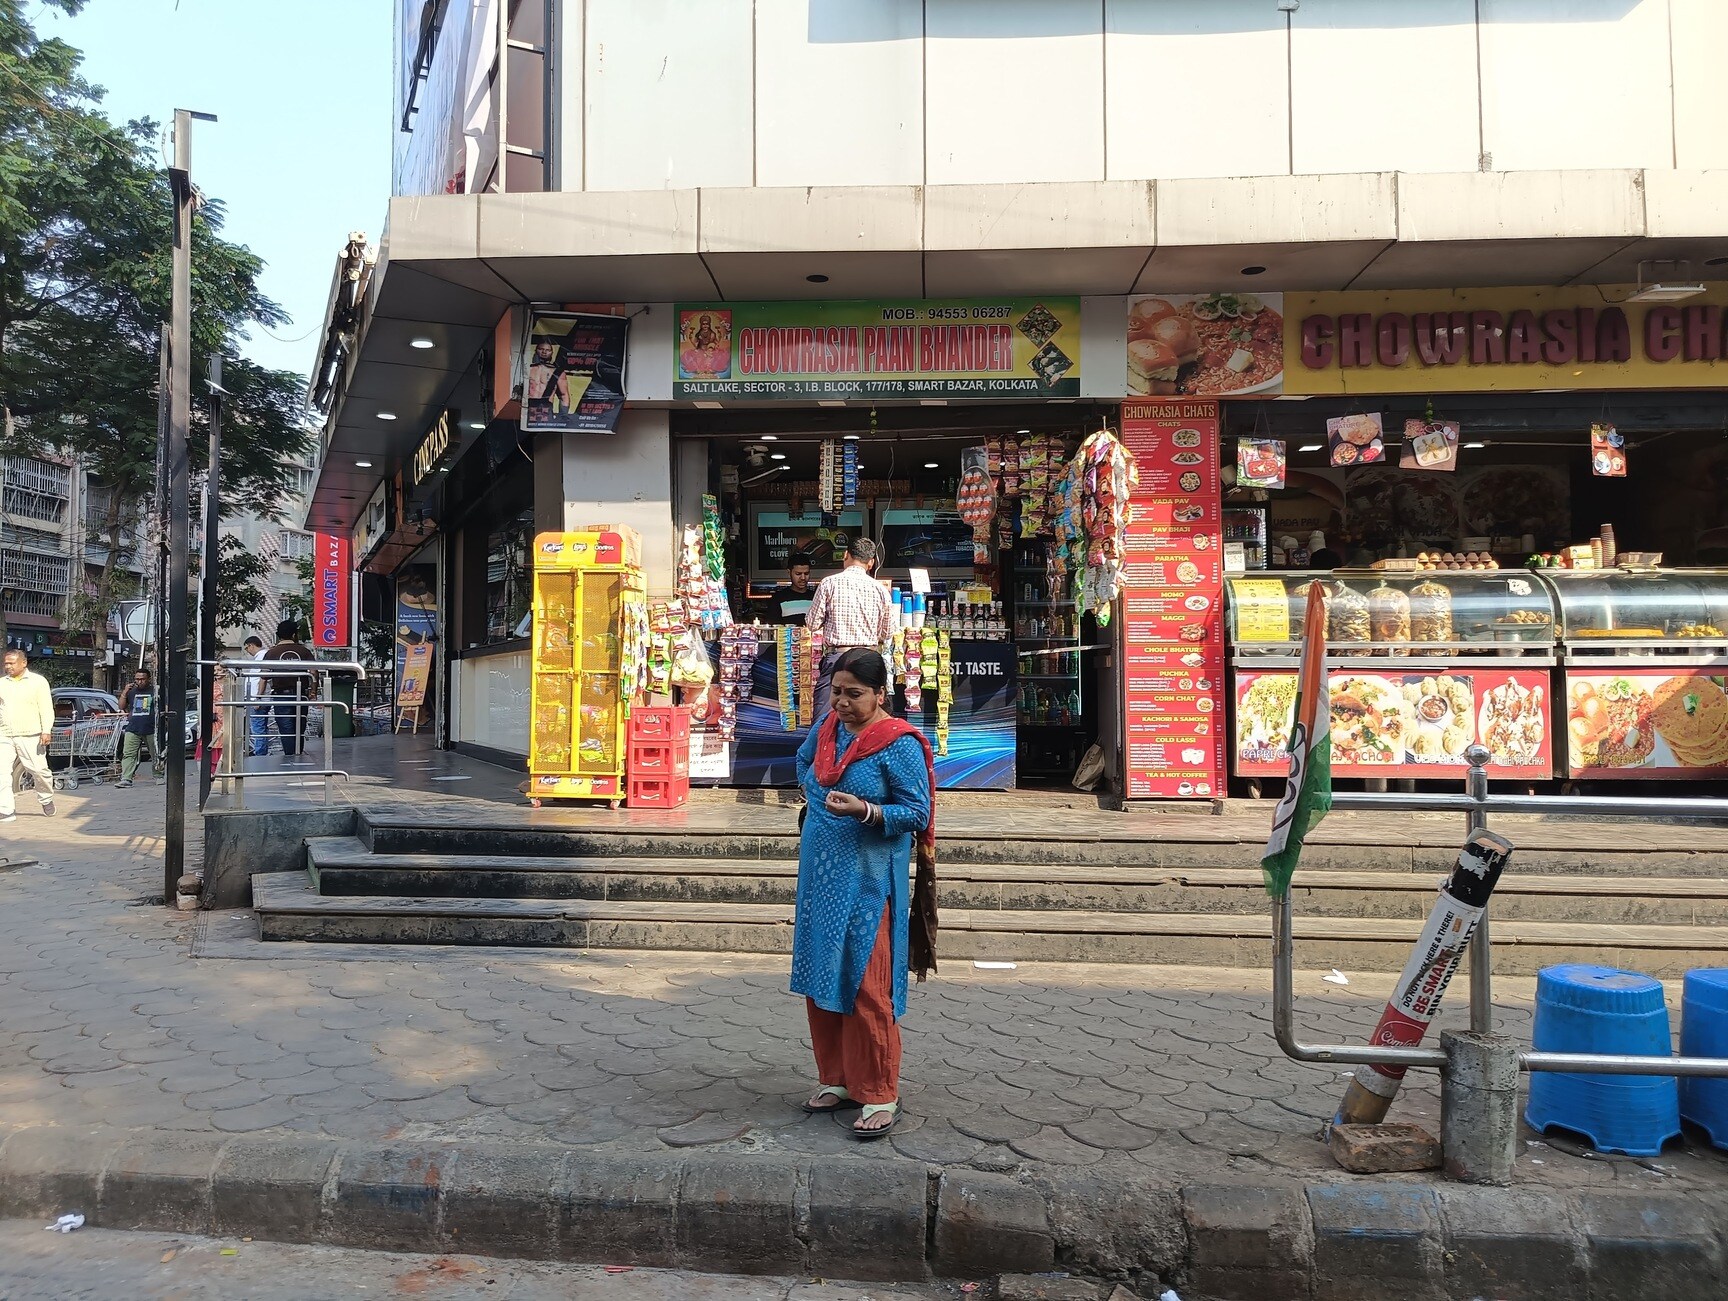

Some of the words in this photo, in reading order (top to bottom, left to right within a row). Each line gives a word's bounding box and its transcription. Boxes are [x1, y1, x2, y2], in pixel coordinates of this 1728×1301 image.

[882, 307, 924, 320] MOB.:
[928, 307, 968, 319] 94553
[972, 306, 1012, 319] 06287
[1300, 307, 1632, 370] CHOWRASIA
[1645, 304, 1728, 363] CH
[739, 326, 861, 375] CHOWRASIA
[863, 324, 917, 373] PAAN
[920, 323, 1014, 373] BHANDER
[683, 384, 709, 393] SALT
[711, 383, 741, 394] LAKE,
[744, 382, 784, 392] SECTOR
[805, 382, 822, 392] I.B.
[824, 381, 864, 394] BLOCK,
[866, 381, 905, 393] 177/178,
[908, 380, 944, 391] SMART
[947, 380, 987, 392] BAZAR,
[989, 379, 1039, 391] KOLKATA
[1124, 405, 1181, 419] CHOWRASIA
[1183, 404, 1215, 418] CHATS
[764, 531, 798, 542] Marlboro
[323, 568, 338, 627] SMART
[965, 661, 1004, 676] TASTE.
[1345, 750, 1396, 762] KACHORI
[1437, 910, 1455, 936] THERE!
[1435, 936, 1442, 944] &
[1425, 942, 1440, 963] HERE
[1403, 995, 1413, 1008] DO
[1412, 995, 1430, 1015] BE
[1426, 994, 1442, 1016] BIN
